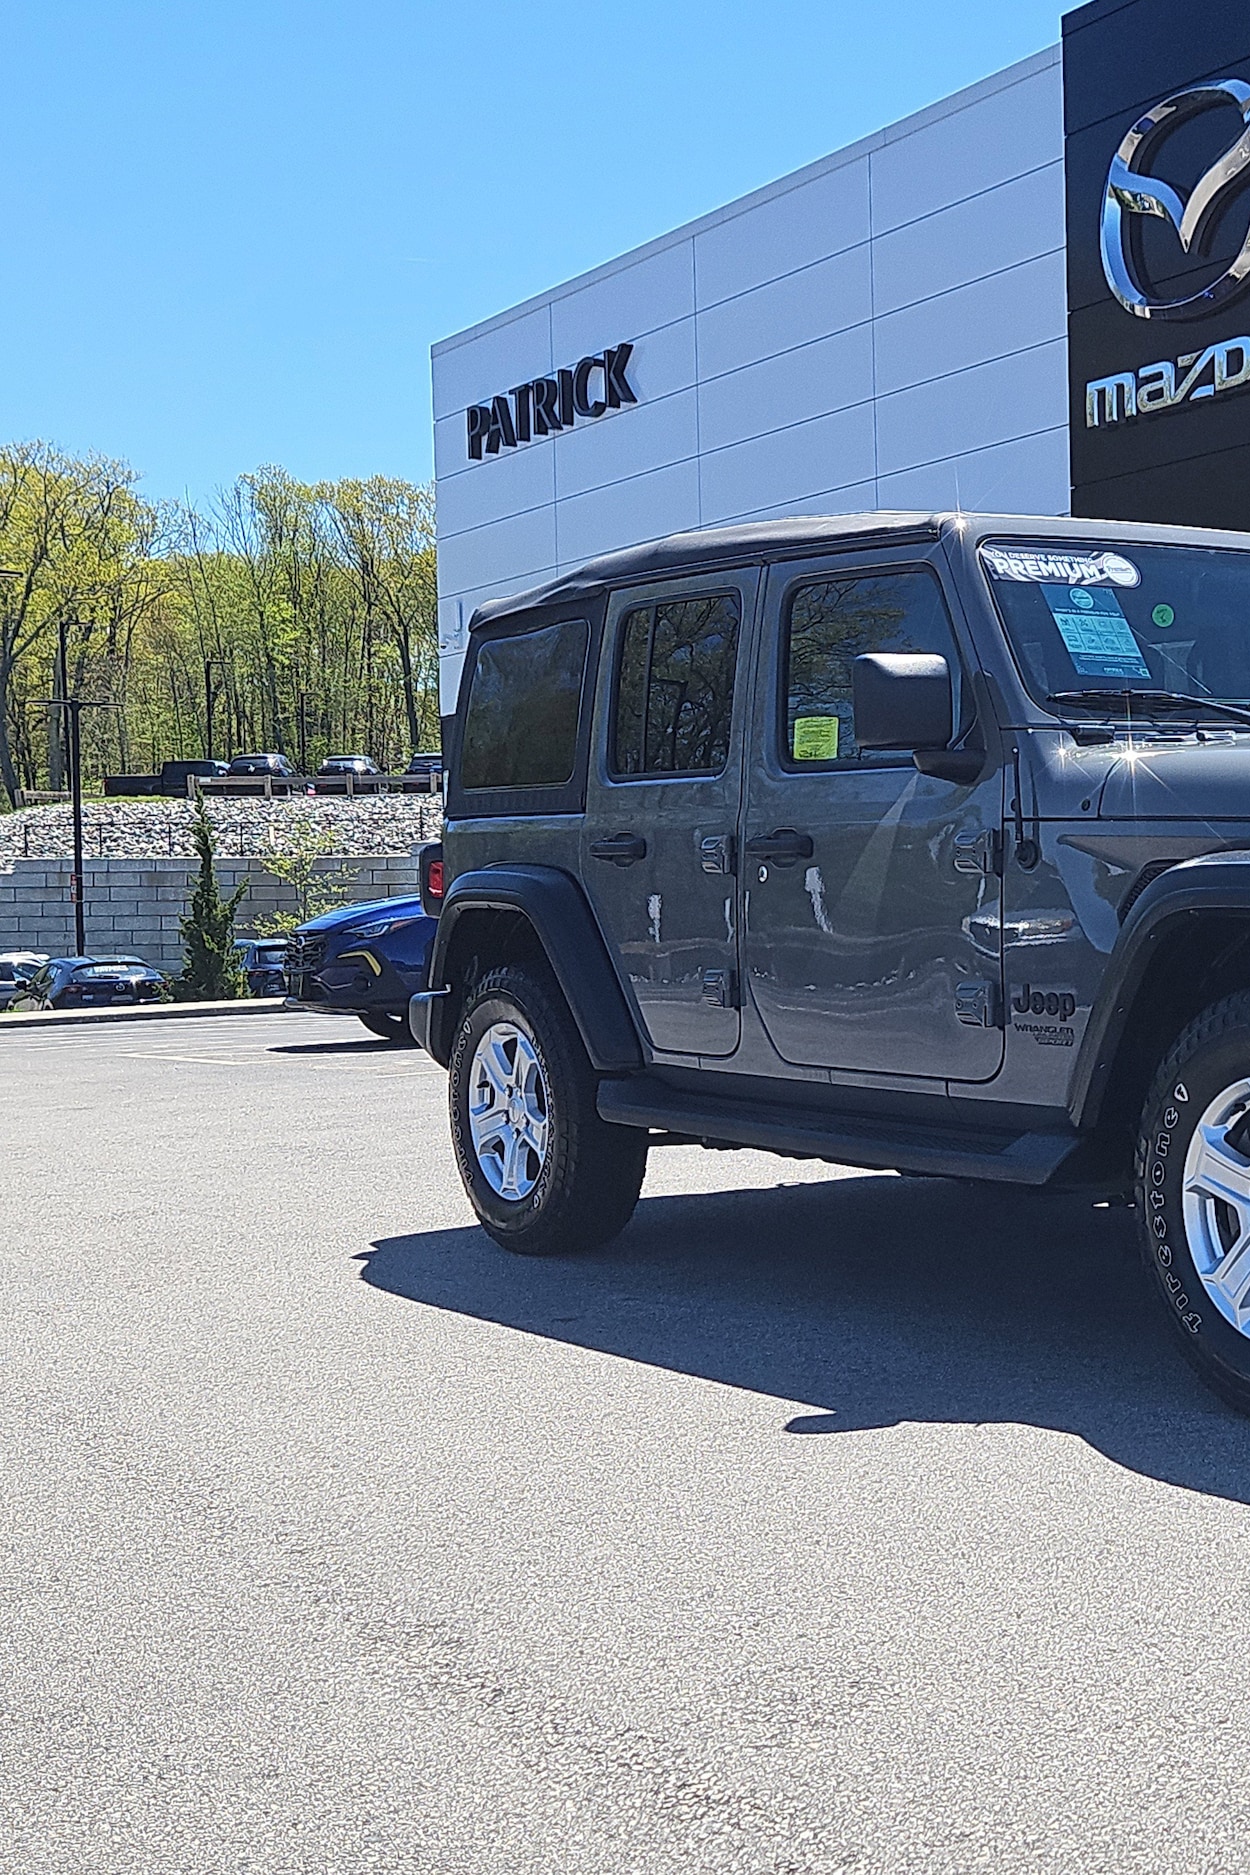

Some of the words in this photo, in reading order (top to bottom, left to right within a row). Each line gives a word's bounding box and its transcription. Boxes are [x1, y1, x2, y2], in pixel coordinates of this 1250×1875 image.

[467, 343, 638, 460] PATRICK
[992, 558, 1101, 579] PREMIUM
[1013, 984, 1075, 1021] Jeep
[1014, 1023, 1075, 1035] WRANGLER
